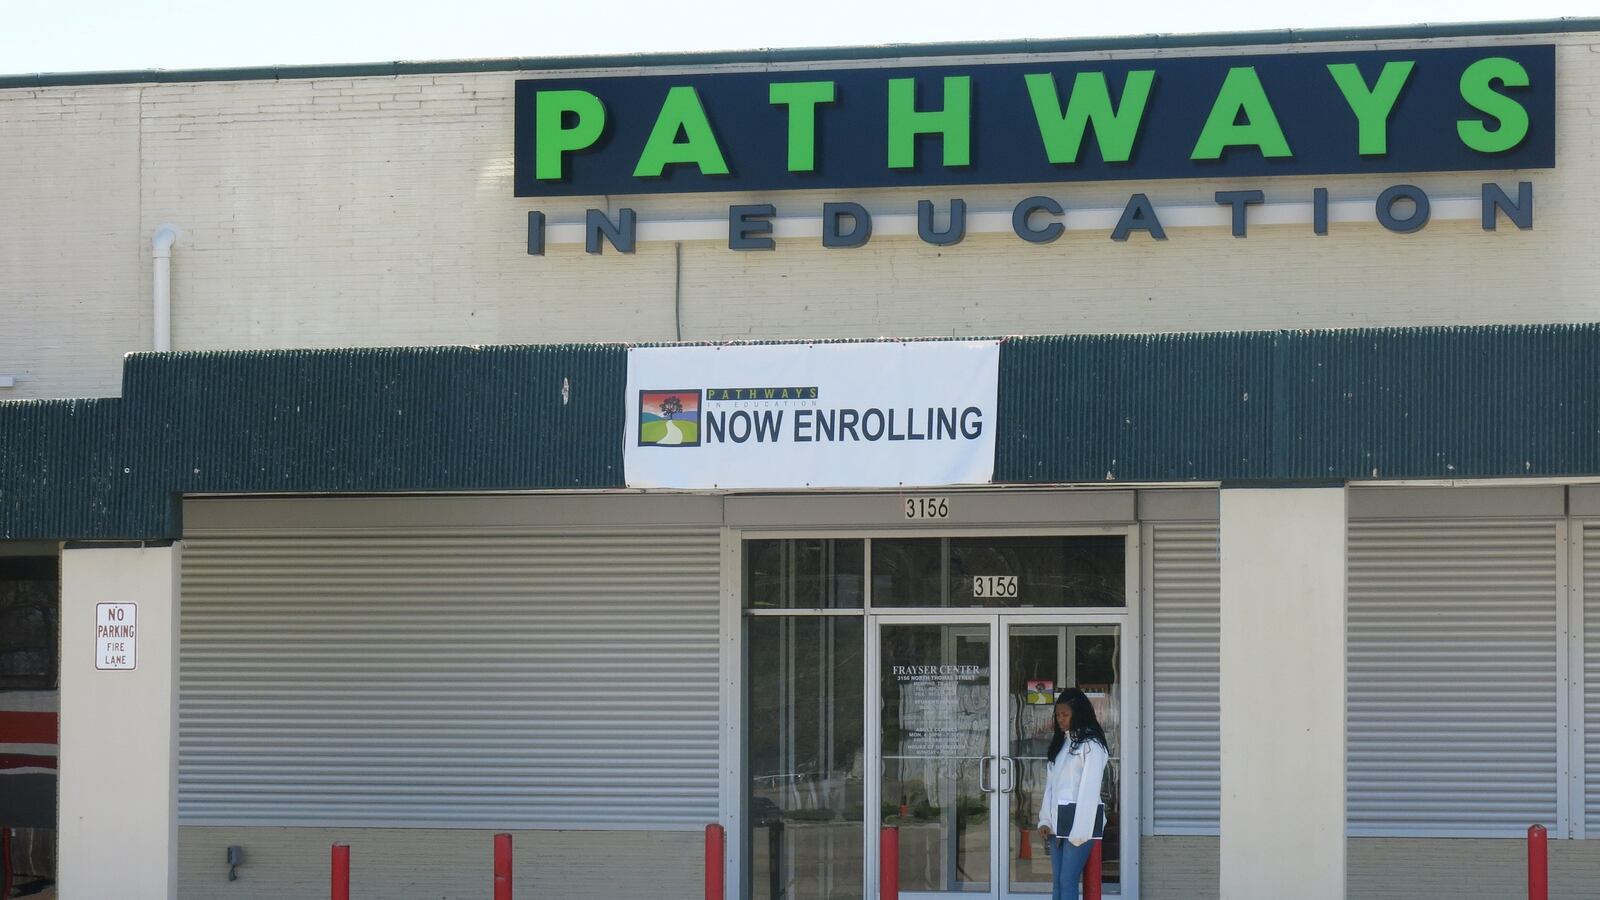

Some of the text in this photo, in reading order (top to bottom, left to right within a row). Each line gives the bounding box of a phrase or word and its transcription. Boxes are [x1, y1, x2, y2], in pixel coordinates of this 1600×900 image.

[536, 57, 1530, 180] PATHWAYS
[527, 181, 1533, 255] IN EDUCATION
[708, 388, 817, 399] PATHWAYS
[706, 406, 983, 443] NOW ENROLLING
[906, 498, 948, 518] 3156
[975, 577, 1017, 596] 3156
[108, 608, 124, 621] NO
[98, 625, 134, 638] PARKING
[107, 642, 125, 652] FIRE
[105, 655, 126, 665] LANE
[892, 665, 980, 675] FRAYSER CENTER
